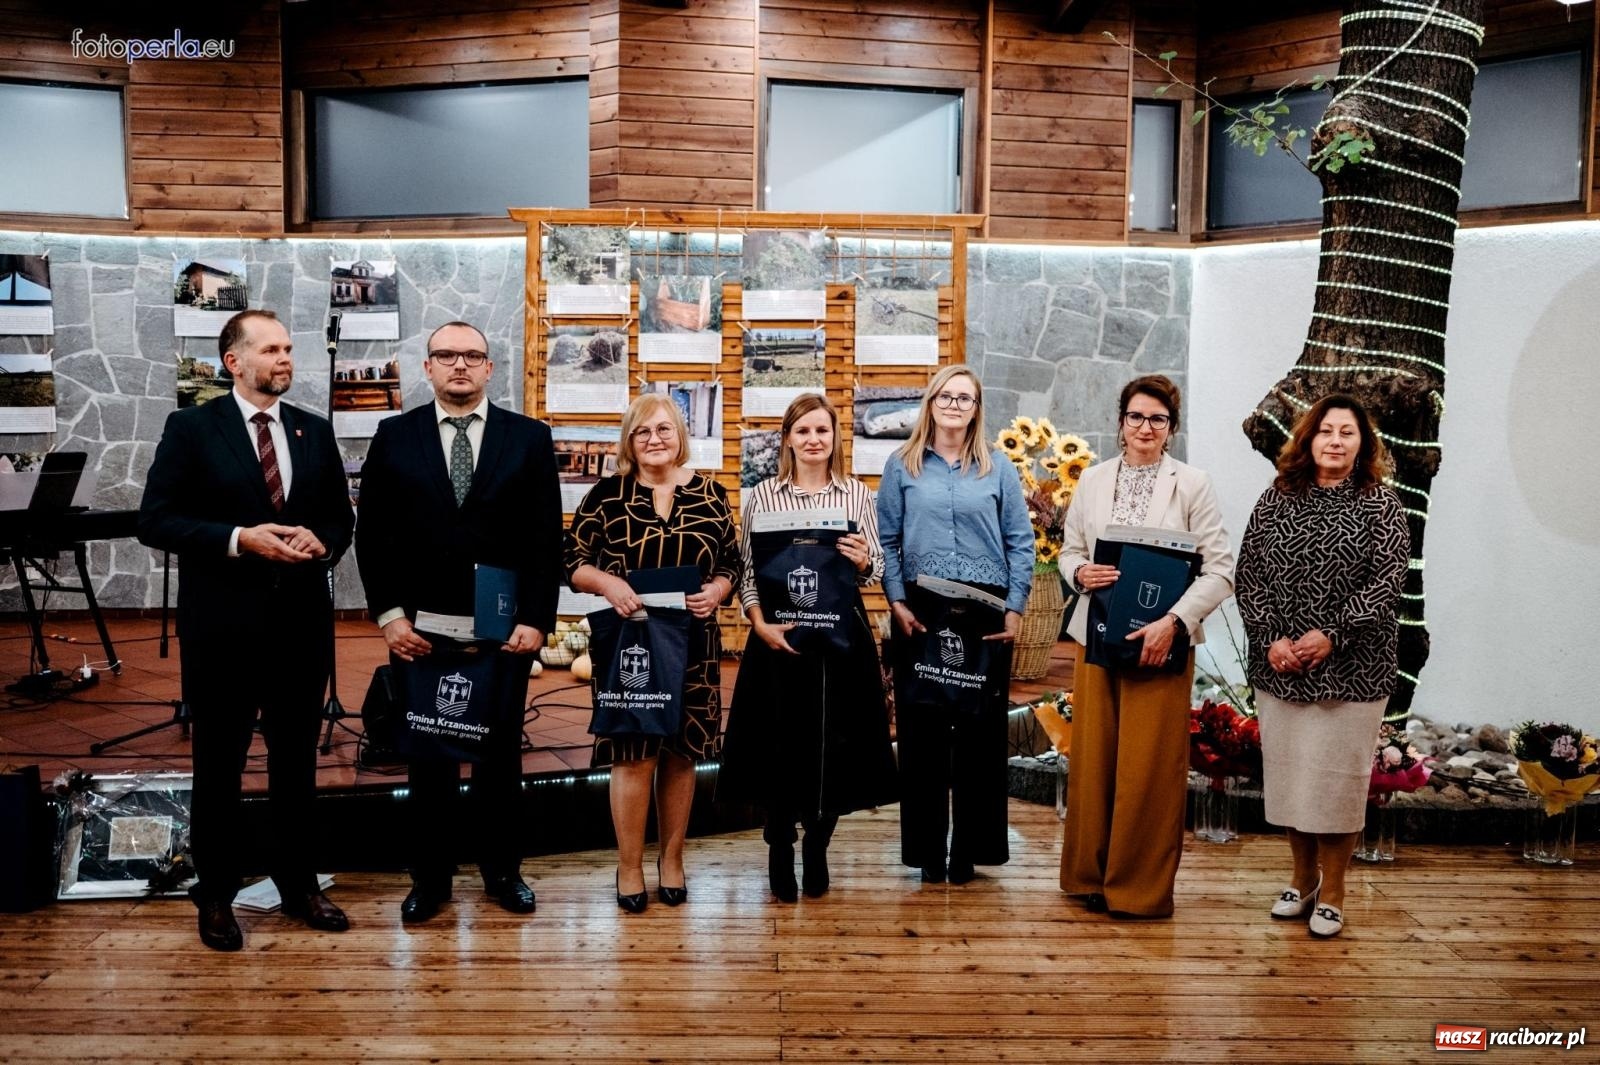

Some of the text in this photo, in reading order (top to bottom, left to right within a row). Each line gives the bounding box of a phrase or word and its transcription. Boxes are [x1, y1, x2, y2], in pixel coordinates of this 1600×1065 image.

[775, 610, 840, 621] Gmina Krzanowice
[914, 662, 987, 682] Gmina Krzanowice
[623, 690, 672, 701] Krzanowice
[406, 711, 490, 734] Gmina Krzanowice
[410, 722, 416, 730] Z
